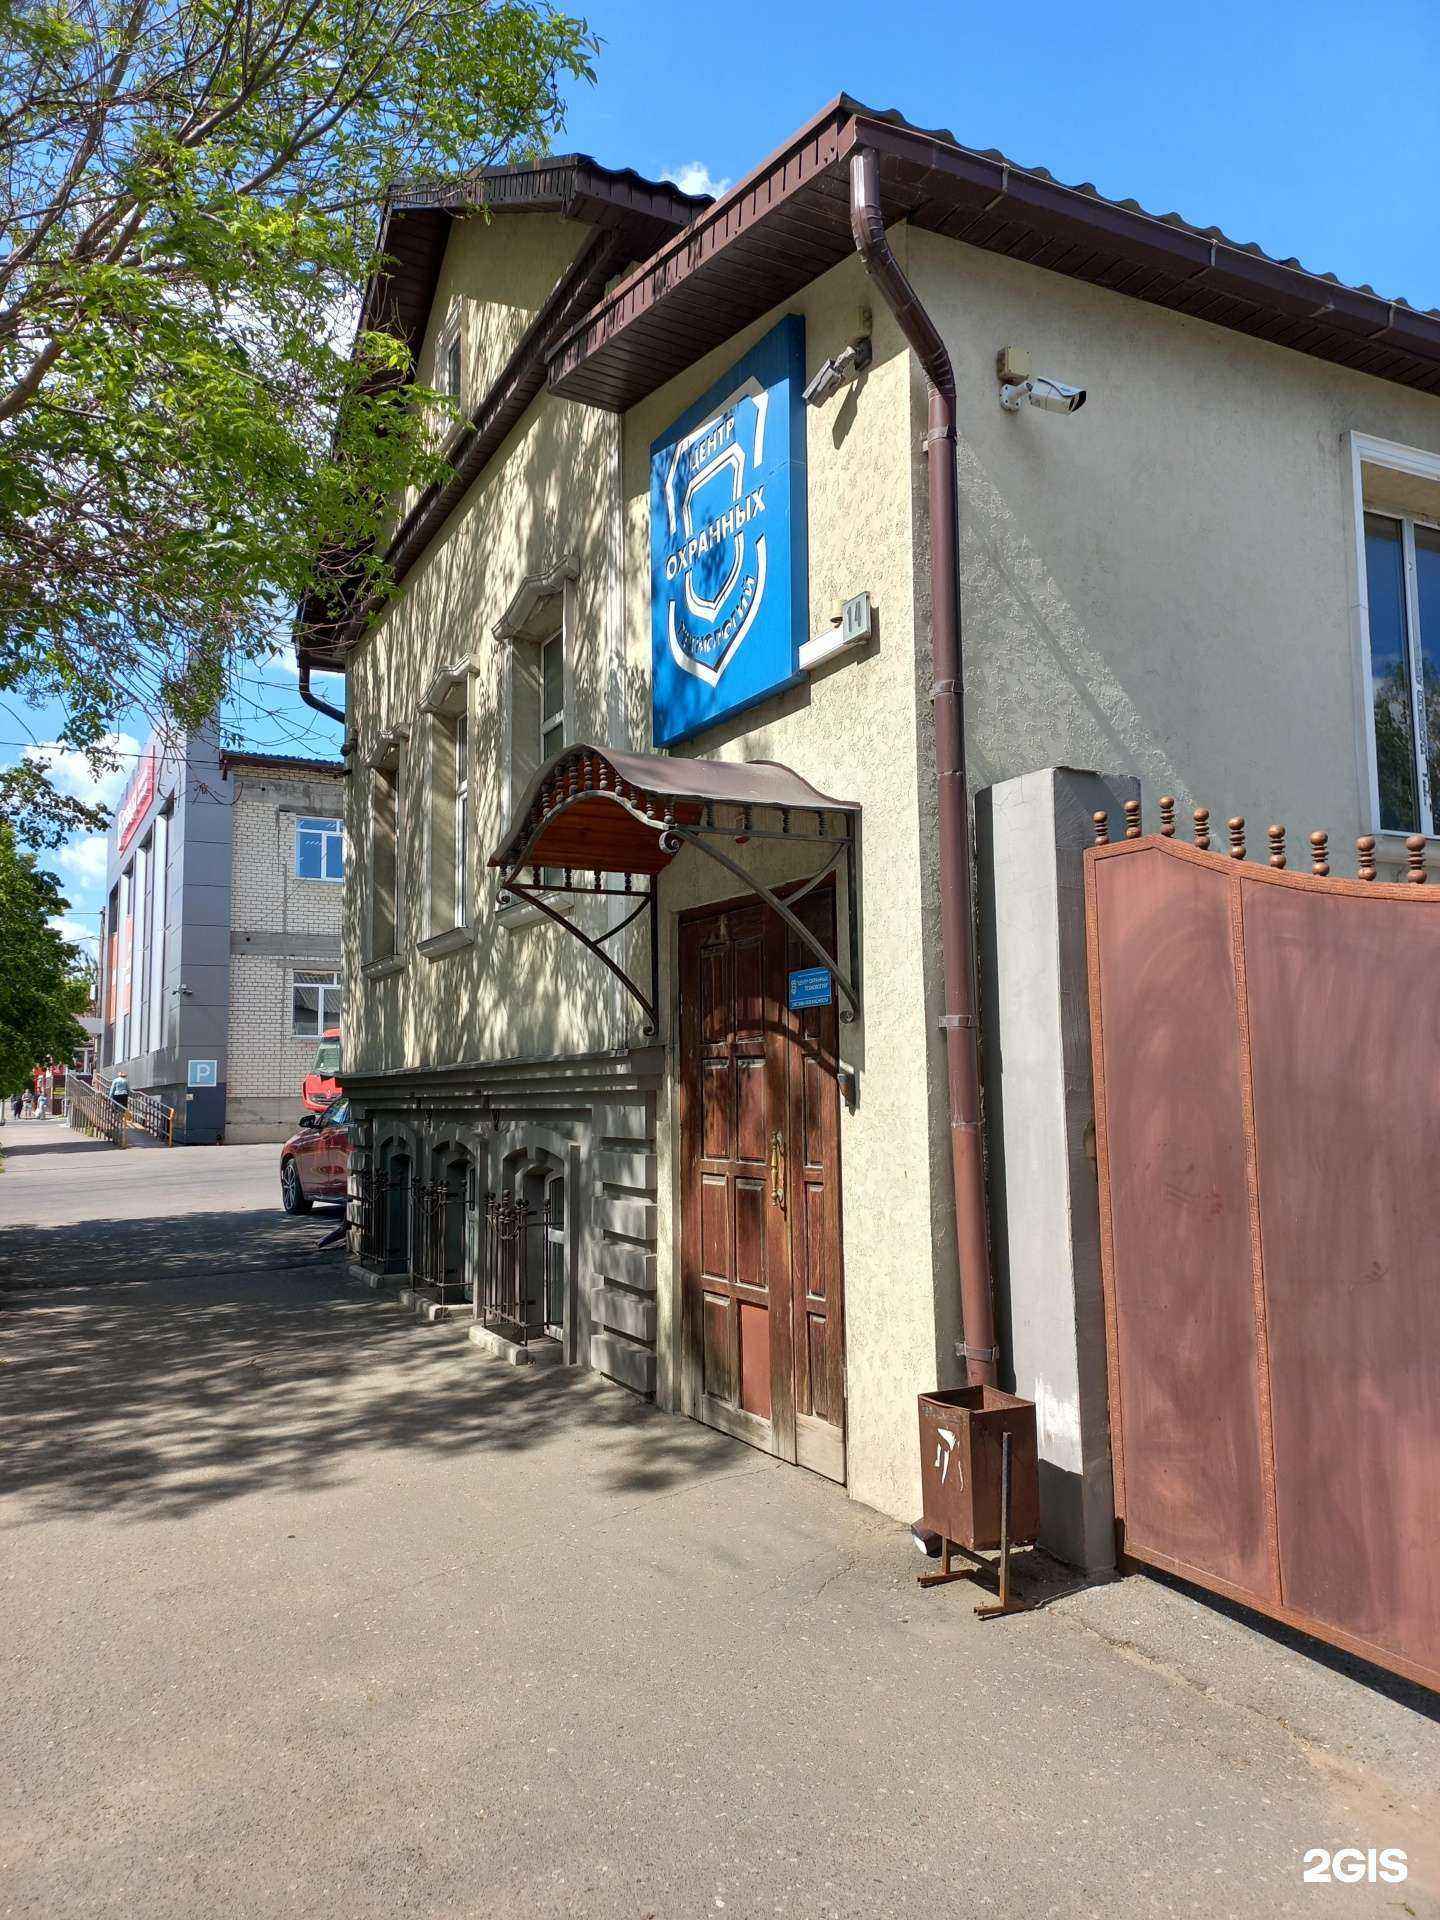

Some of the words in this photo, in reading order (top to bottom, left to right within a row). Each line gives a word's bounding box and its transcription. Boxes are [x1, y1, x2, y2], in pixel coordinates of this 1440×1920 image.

[689, 415, 735, 470] ЦЕНТР
[665, 485, 766, 581] ОХРАННЫХ
[846, 600, 862, 633] 14
[196, 1063, 210, 1083] P
